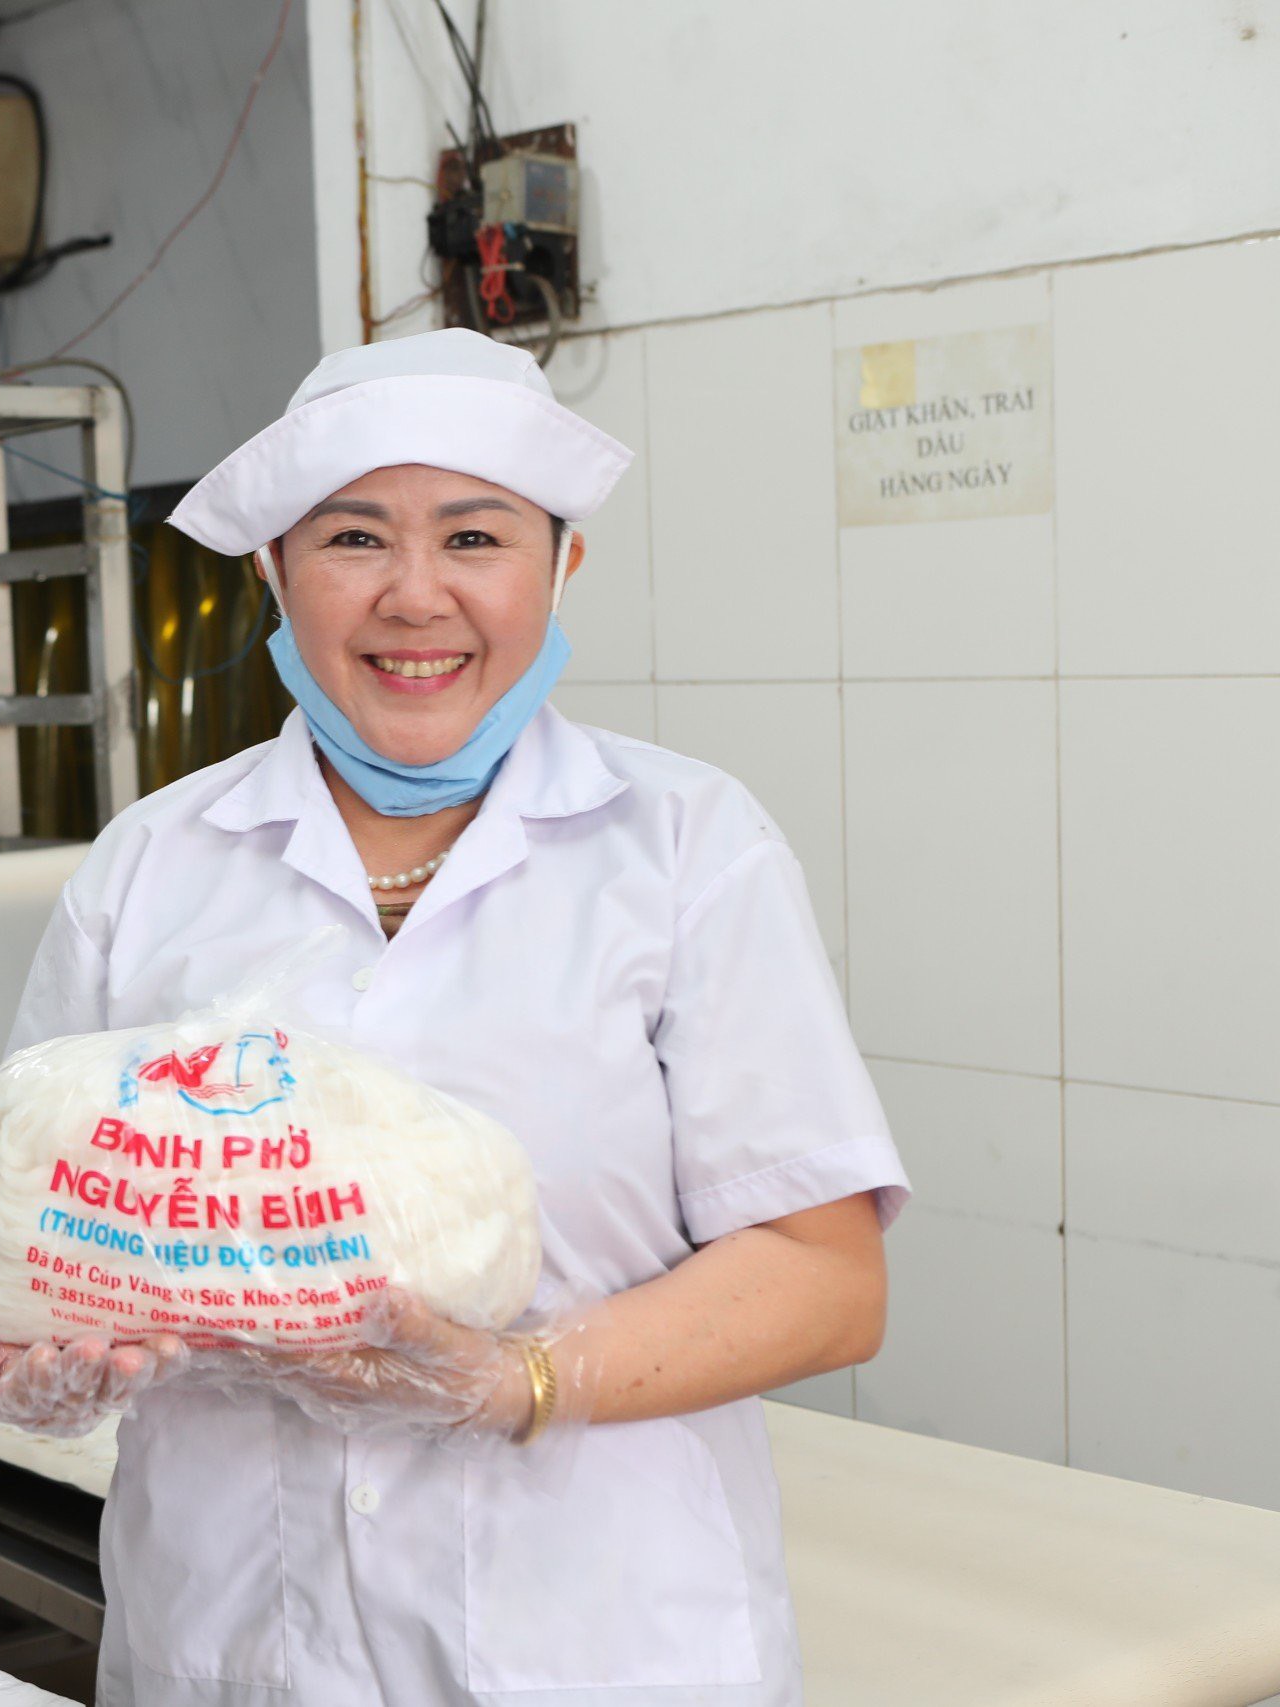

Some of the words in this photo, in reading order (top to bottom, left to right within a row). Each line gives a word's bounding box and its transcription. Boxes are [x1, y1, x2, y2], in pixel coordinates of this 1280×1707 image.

[50, 1159, 239, 1229] NGUYỄN
[27, 1246, 48, 1267] Đã
[53, 1257, 82, 1279] Đạt
[88, 1266, 121, 1290] Cúp
[129, 1275, 173, 1303] Vàng
[200, 1288, 236, 1307] Sức
[31, 1278, 54, 1297] ĐT:
[59, 1286, 136, 1316] 38152011
[273, 1317, 309, 1331] Fax:
[51, 1307, 107, 1329] Website:
